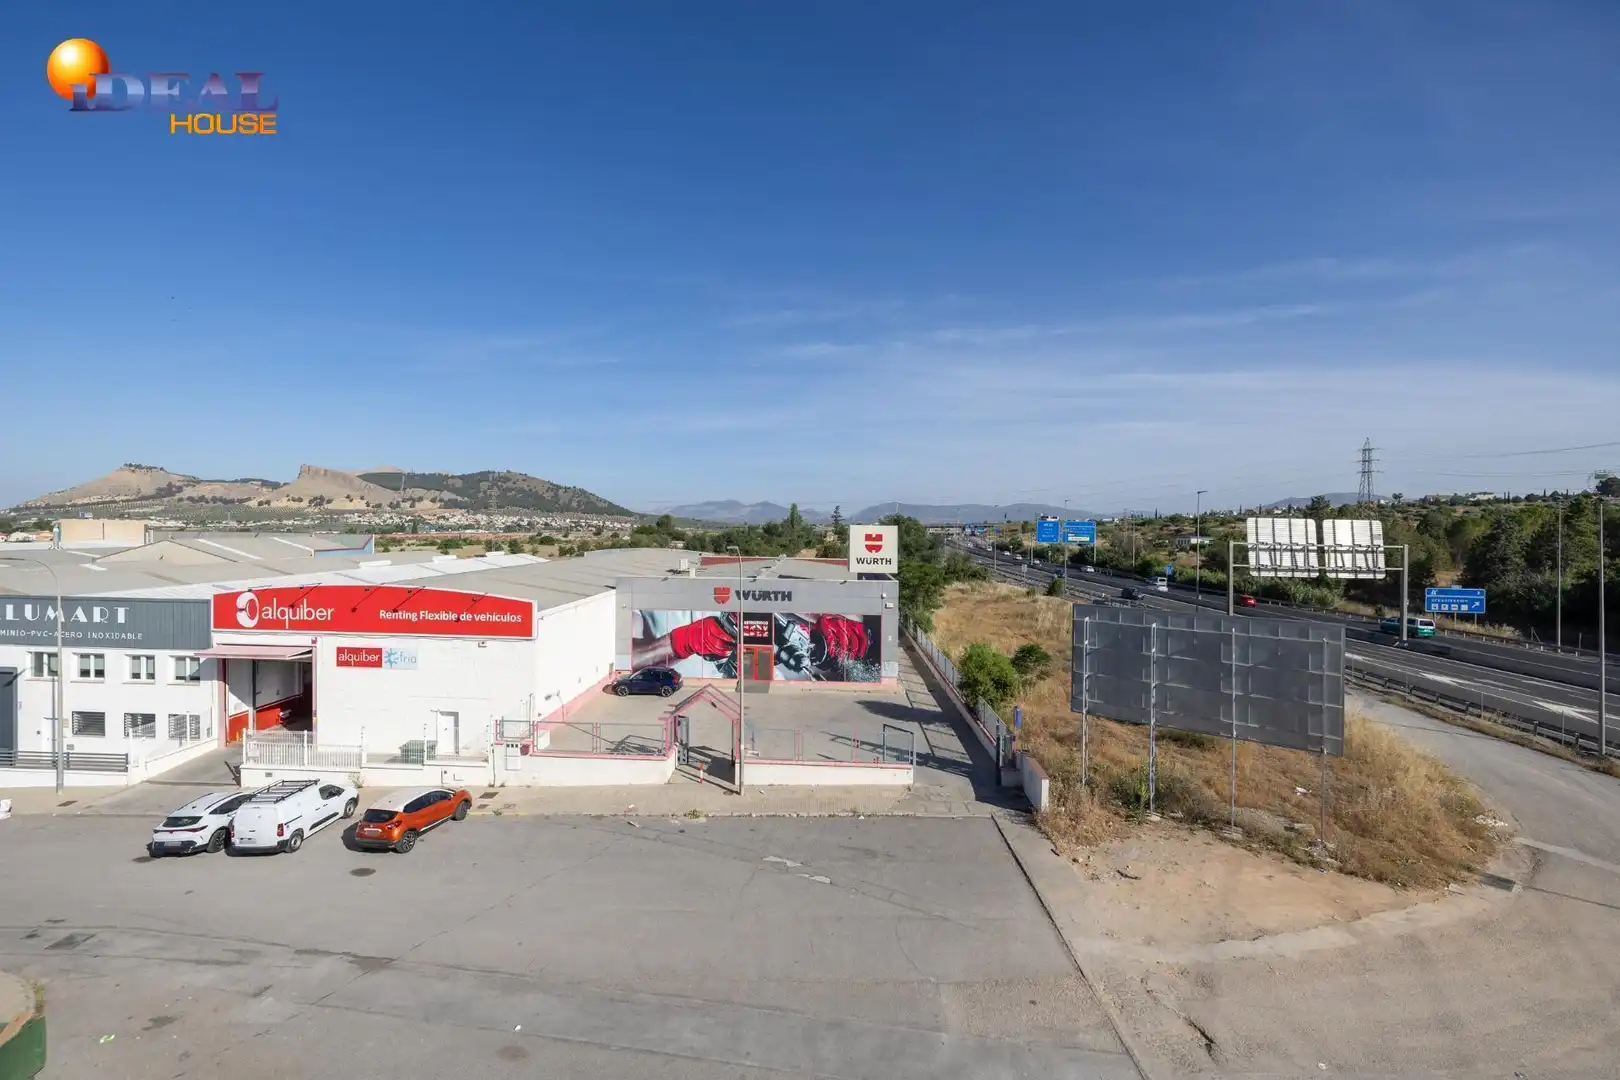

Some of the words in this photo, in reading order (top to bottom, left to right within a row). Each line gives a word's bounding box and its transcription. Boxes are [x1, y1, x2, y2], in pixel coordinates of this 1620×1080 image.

[856, 556, 892, 566] WÜRTH
[734, 589, 793, 602] WÜRTH
[0, 603, 130, 624] LUMART
[261, 597, 335, 629] alquiber
[379, 609, 418, 623] Renting
[419, 610, 458, 621] Flexible
[459, 611, 472, 622] de
[87, 631, 143, 640] INOXIDABLE
[338, 648, 381, 667] alquiber
